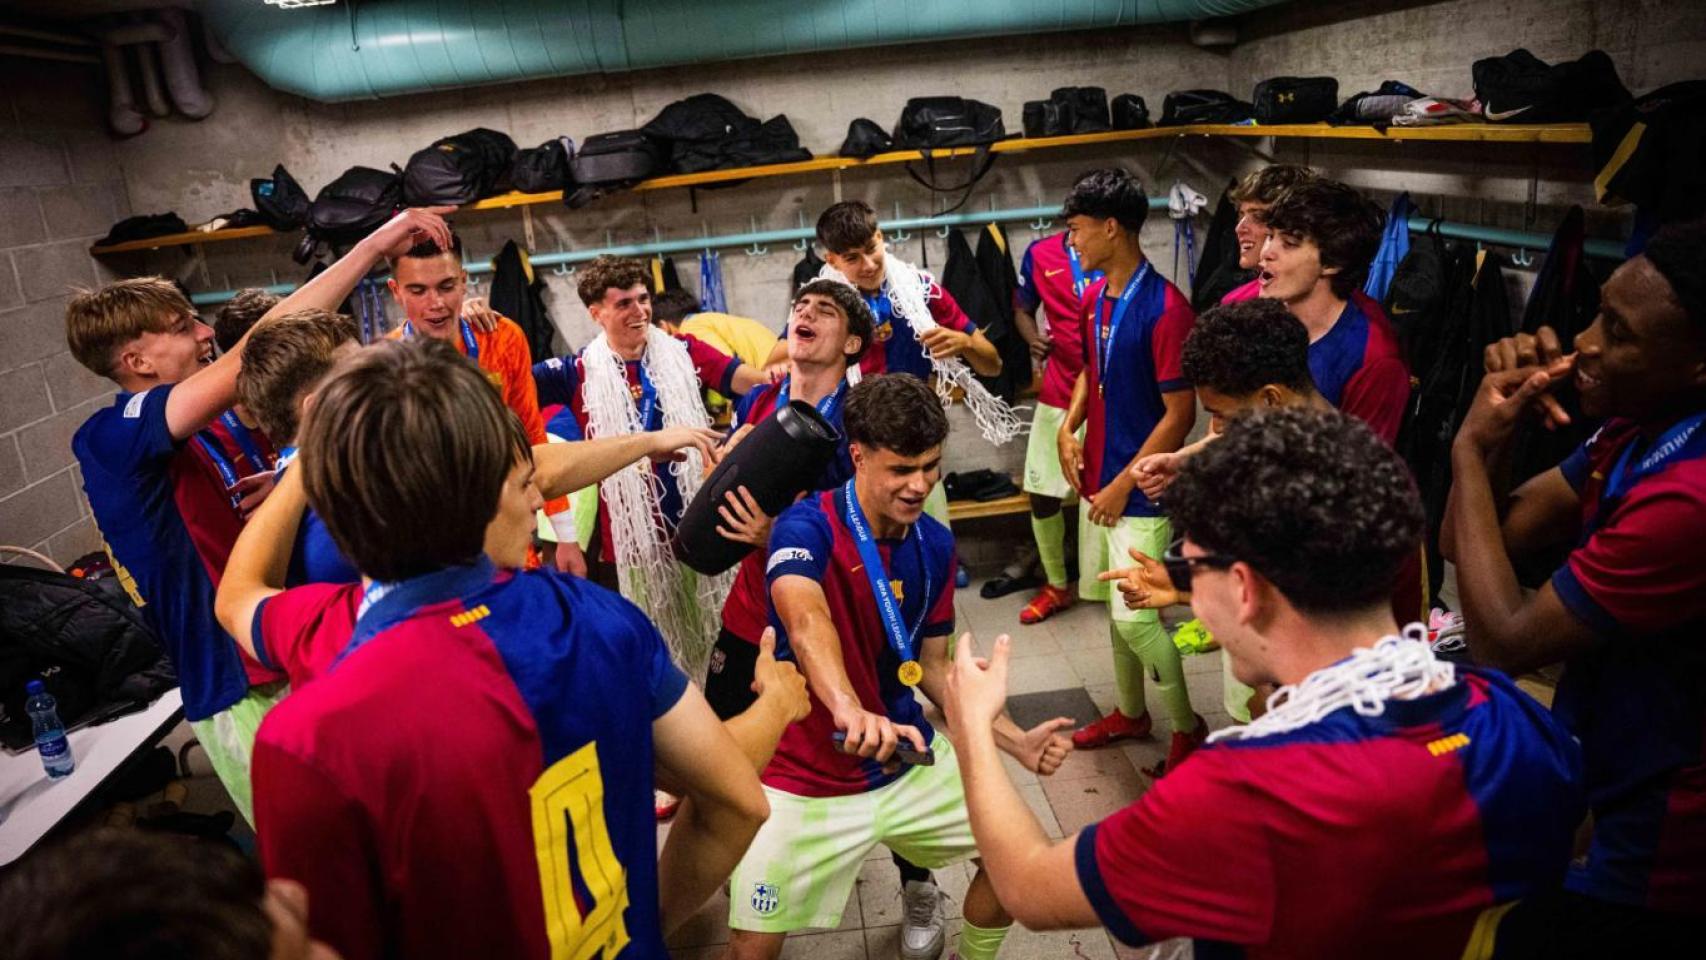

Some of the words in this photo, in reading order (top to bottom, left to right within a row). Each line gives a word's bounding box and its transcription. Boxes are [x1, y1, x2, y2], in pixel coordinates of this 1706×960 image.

[850, 514, 868, 541] LEAGUE
[876, 579, 888, 598] UEFA
[883, 597, 897, 621] YOUTH
[891, 621, 906, 649] LEAGUE
